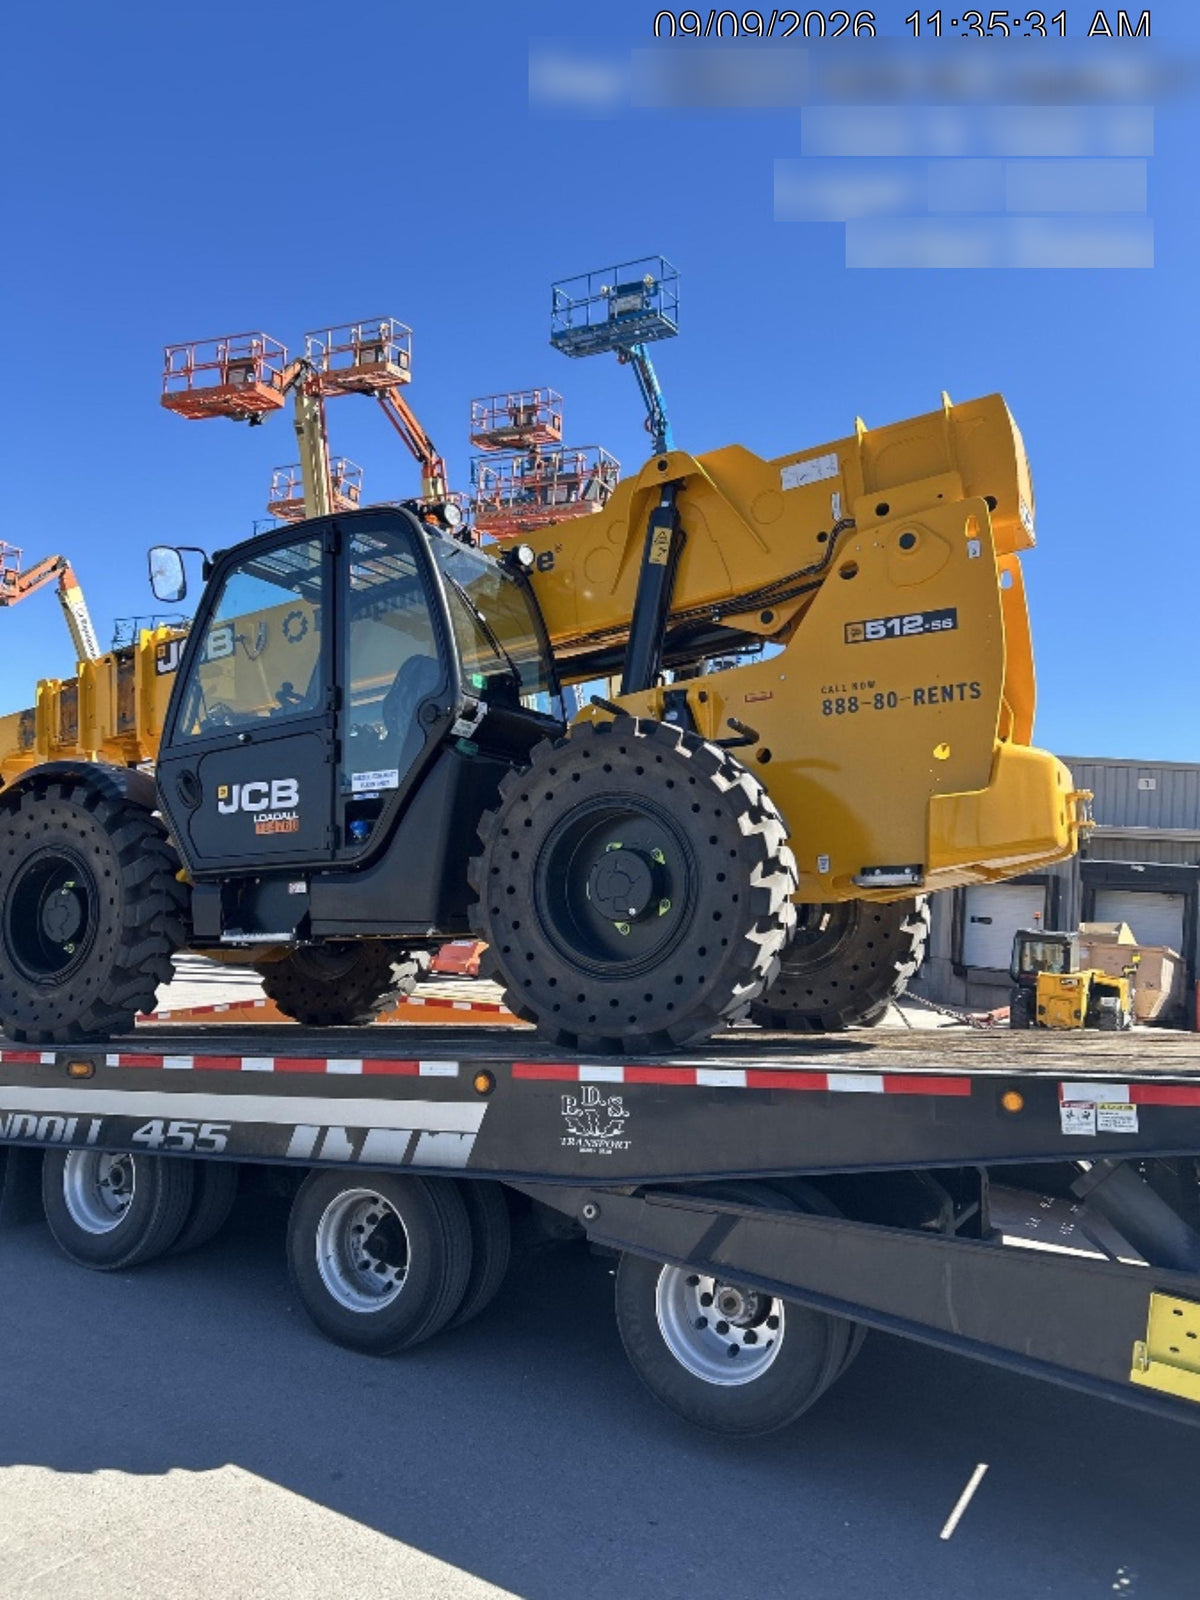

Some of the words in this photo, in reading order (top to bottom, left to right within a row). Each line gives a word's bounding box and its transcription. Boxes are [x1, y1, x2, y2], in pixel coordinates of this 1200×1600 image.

[217, 778, 299, 815] JCB
[131, 1119, 232, 1154] 455
[560, 1137, 632, 1150] TRANSPORT
